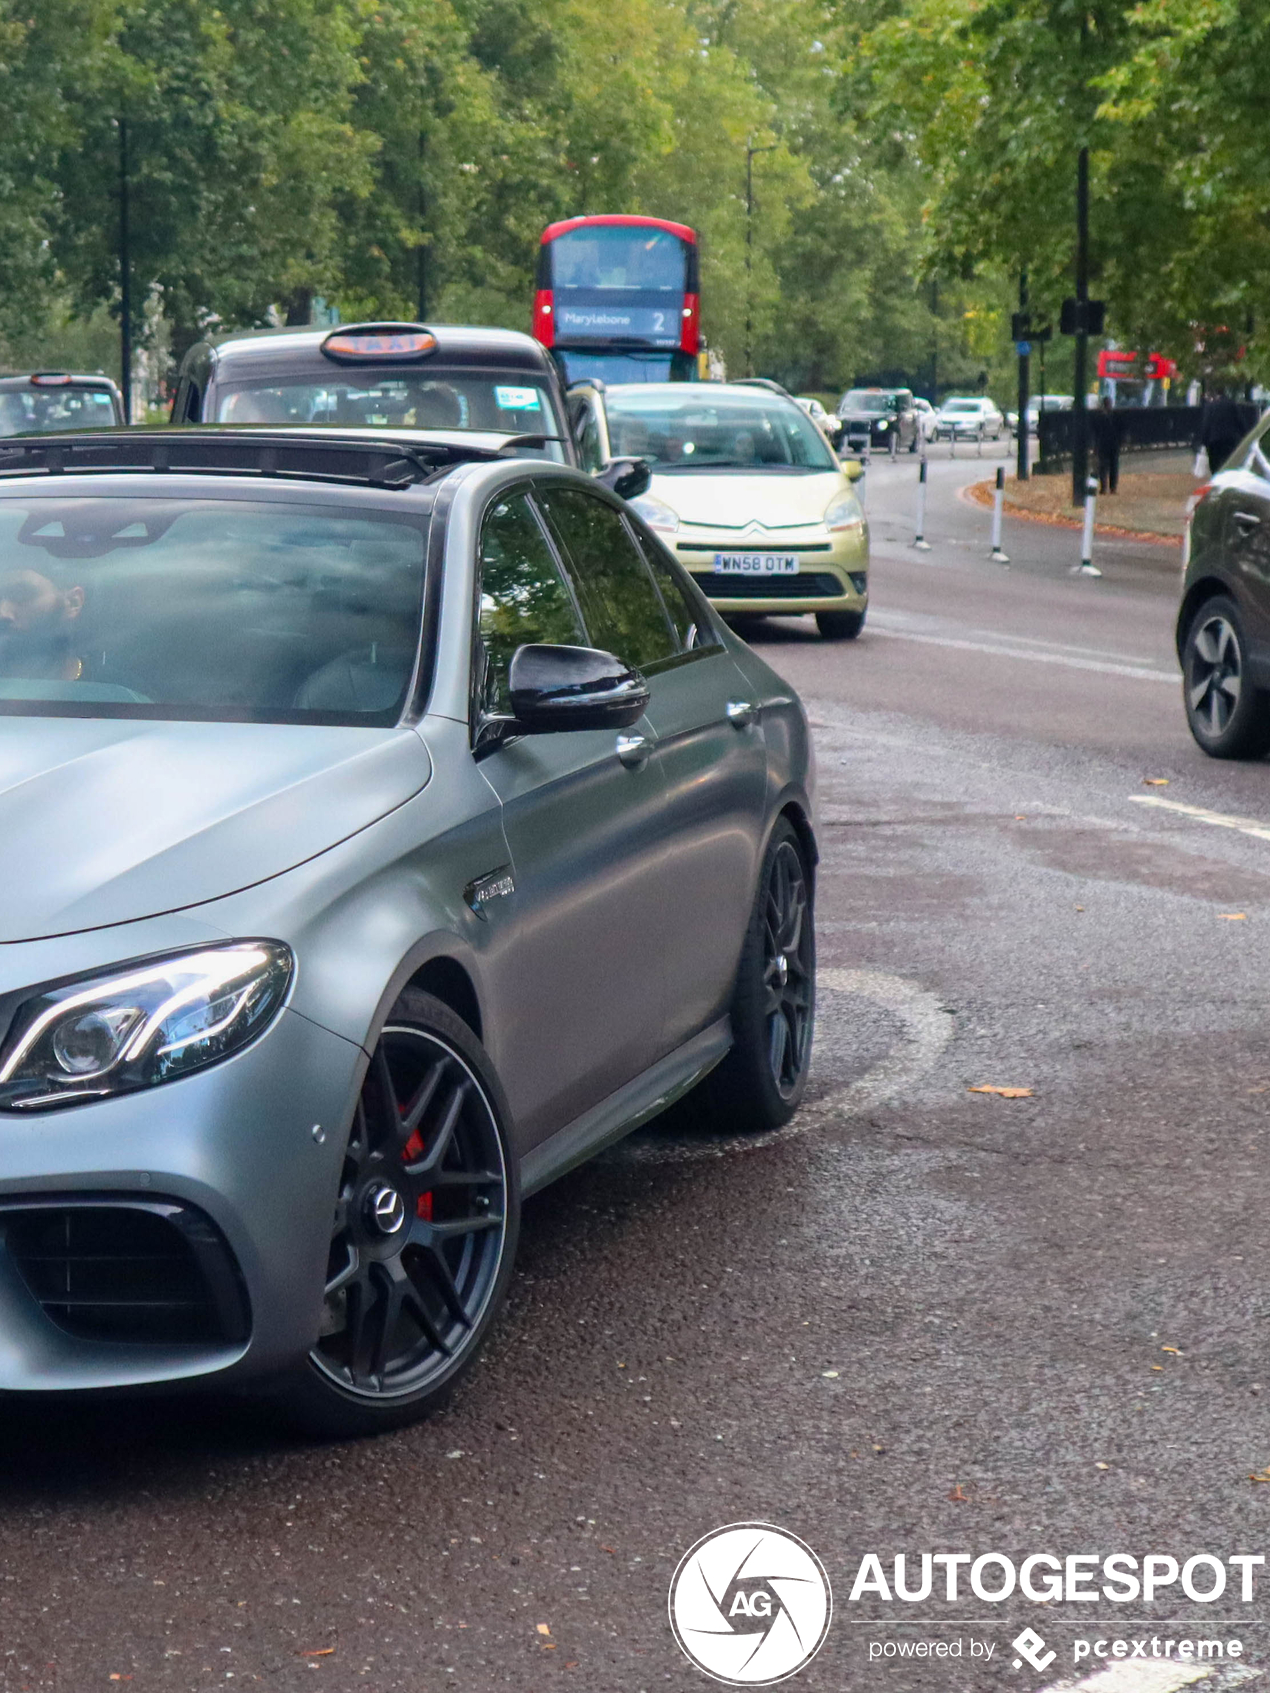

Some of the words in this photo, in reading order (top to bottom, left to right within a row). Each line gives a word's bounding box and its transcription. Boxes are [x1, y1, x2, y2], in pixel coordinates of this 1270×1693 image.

[564, 312, 630, 326] Marylebone
[653, 313, 665, 331] 2
[722, 556, 761, 571] WN58
